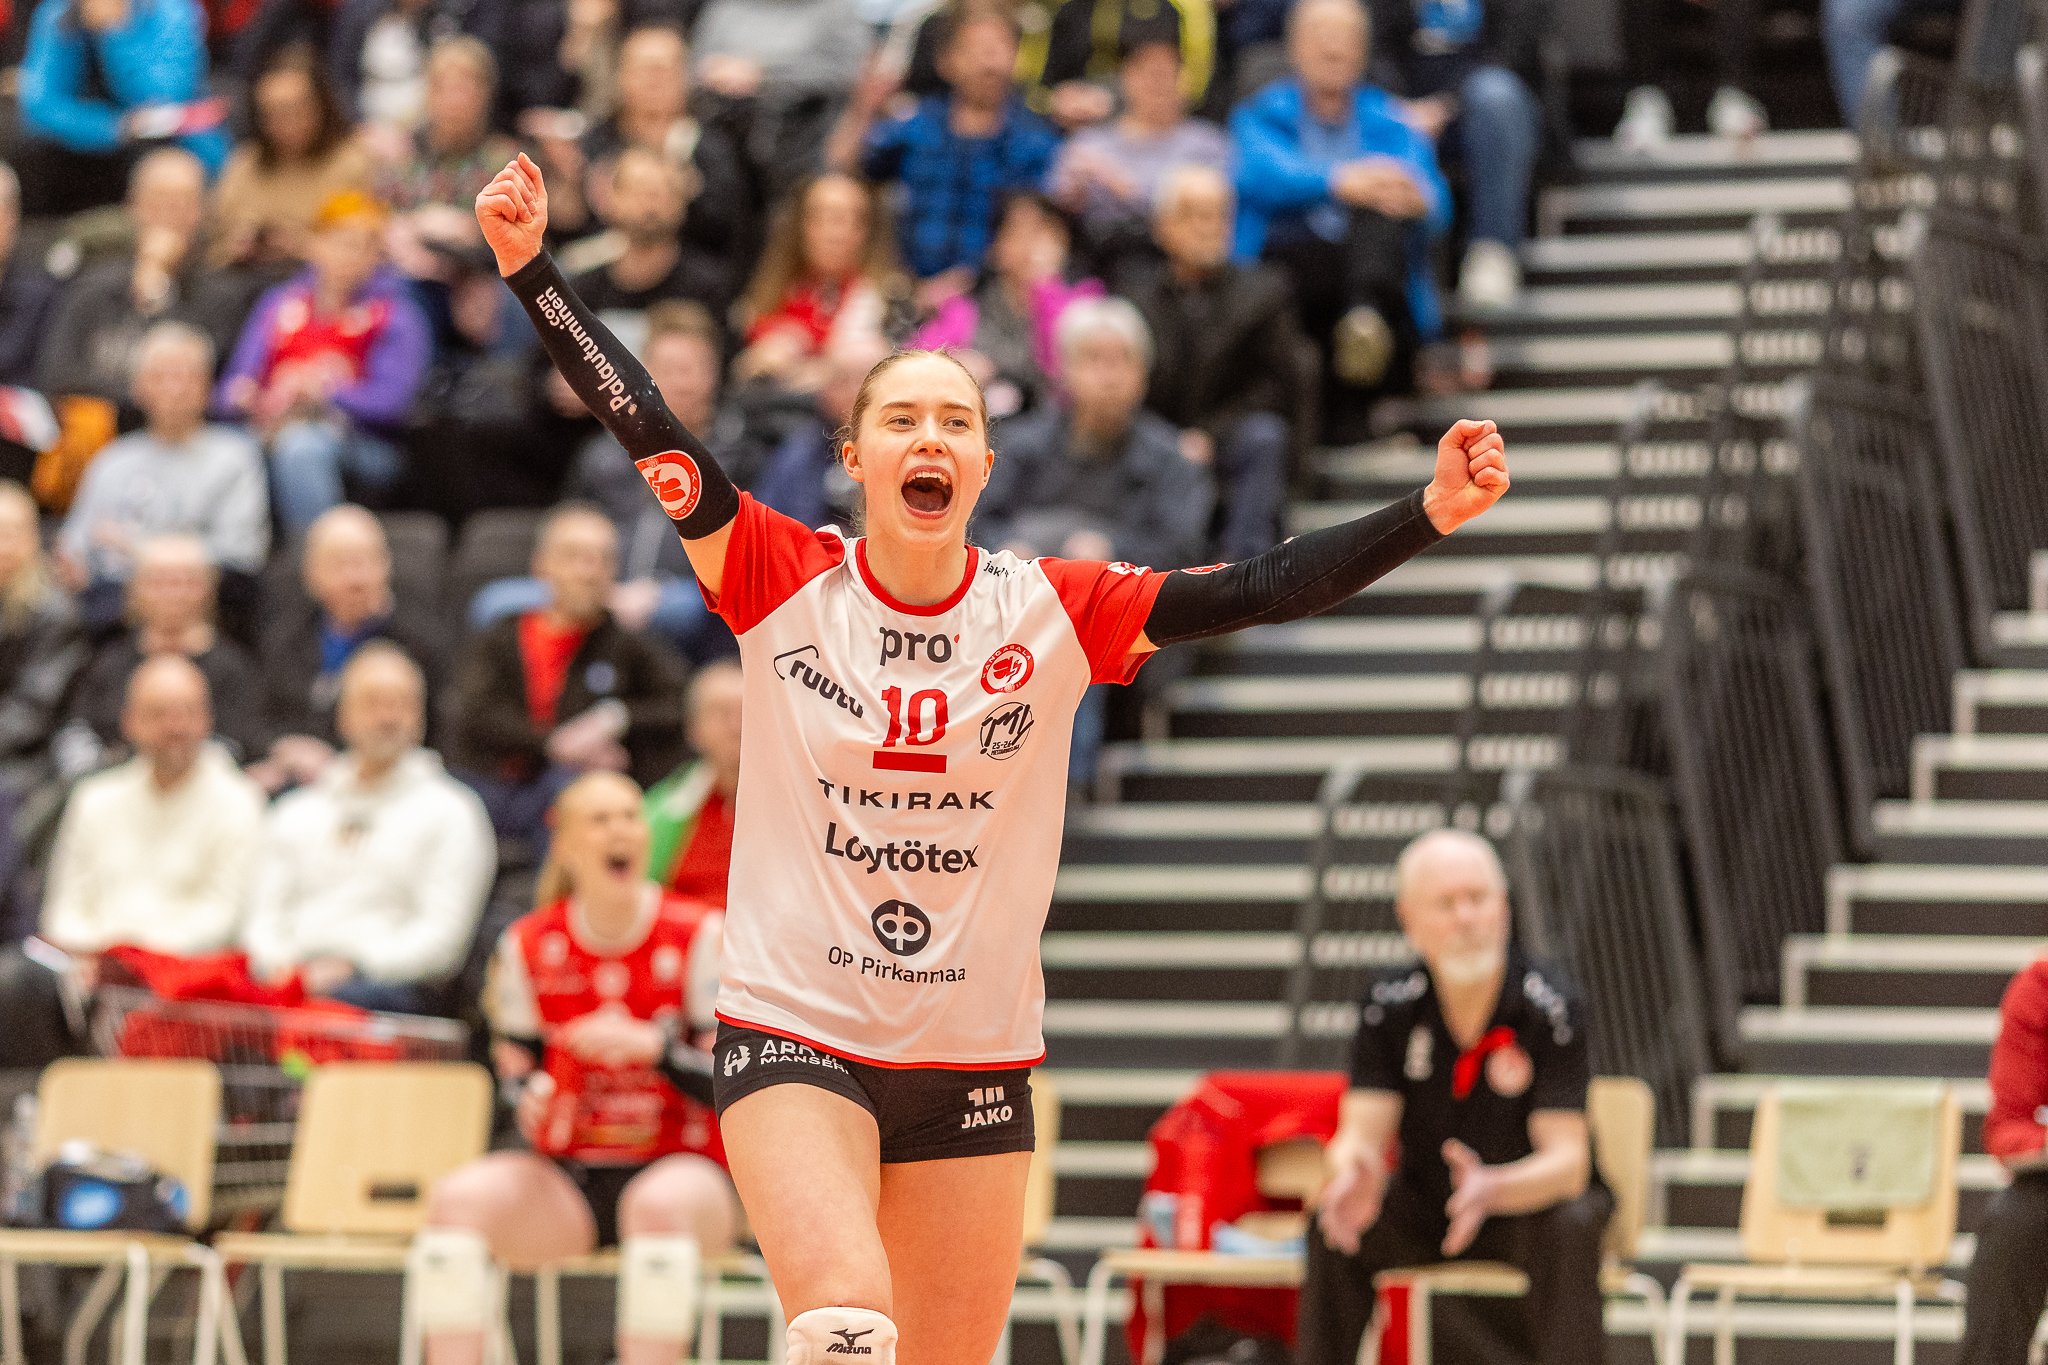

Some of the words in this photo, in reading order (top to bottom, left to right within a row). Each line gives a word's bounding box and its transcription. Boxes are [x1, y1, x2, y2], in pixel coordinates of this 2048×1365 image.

[544, 286, 632, 412] Palautuminen
[789, 659, 863, 718] ruutu
[881, 685, 949, 748] 10
[817, 777, 995, 809] TIKIRAK
[828, 945, 854, 967] OP
[861, 956, 966, 984] Pirkanmaa
[961, 1105, 1013, 1129] JAKO
